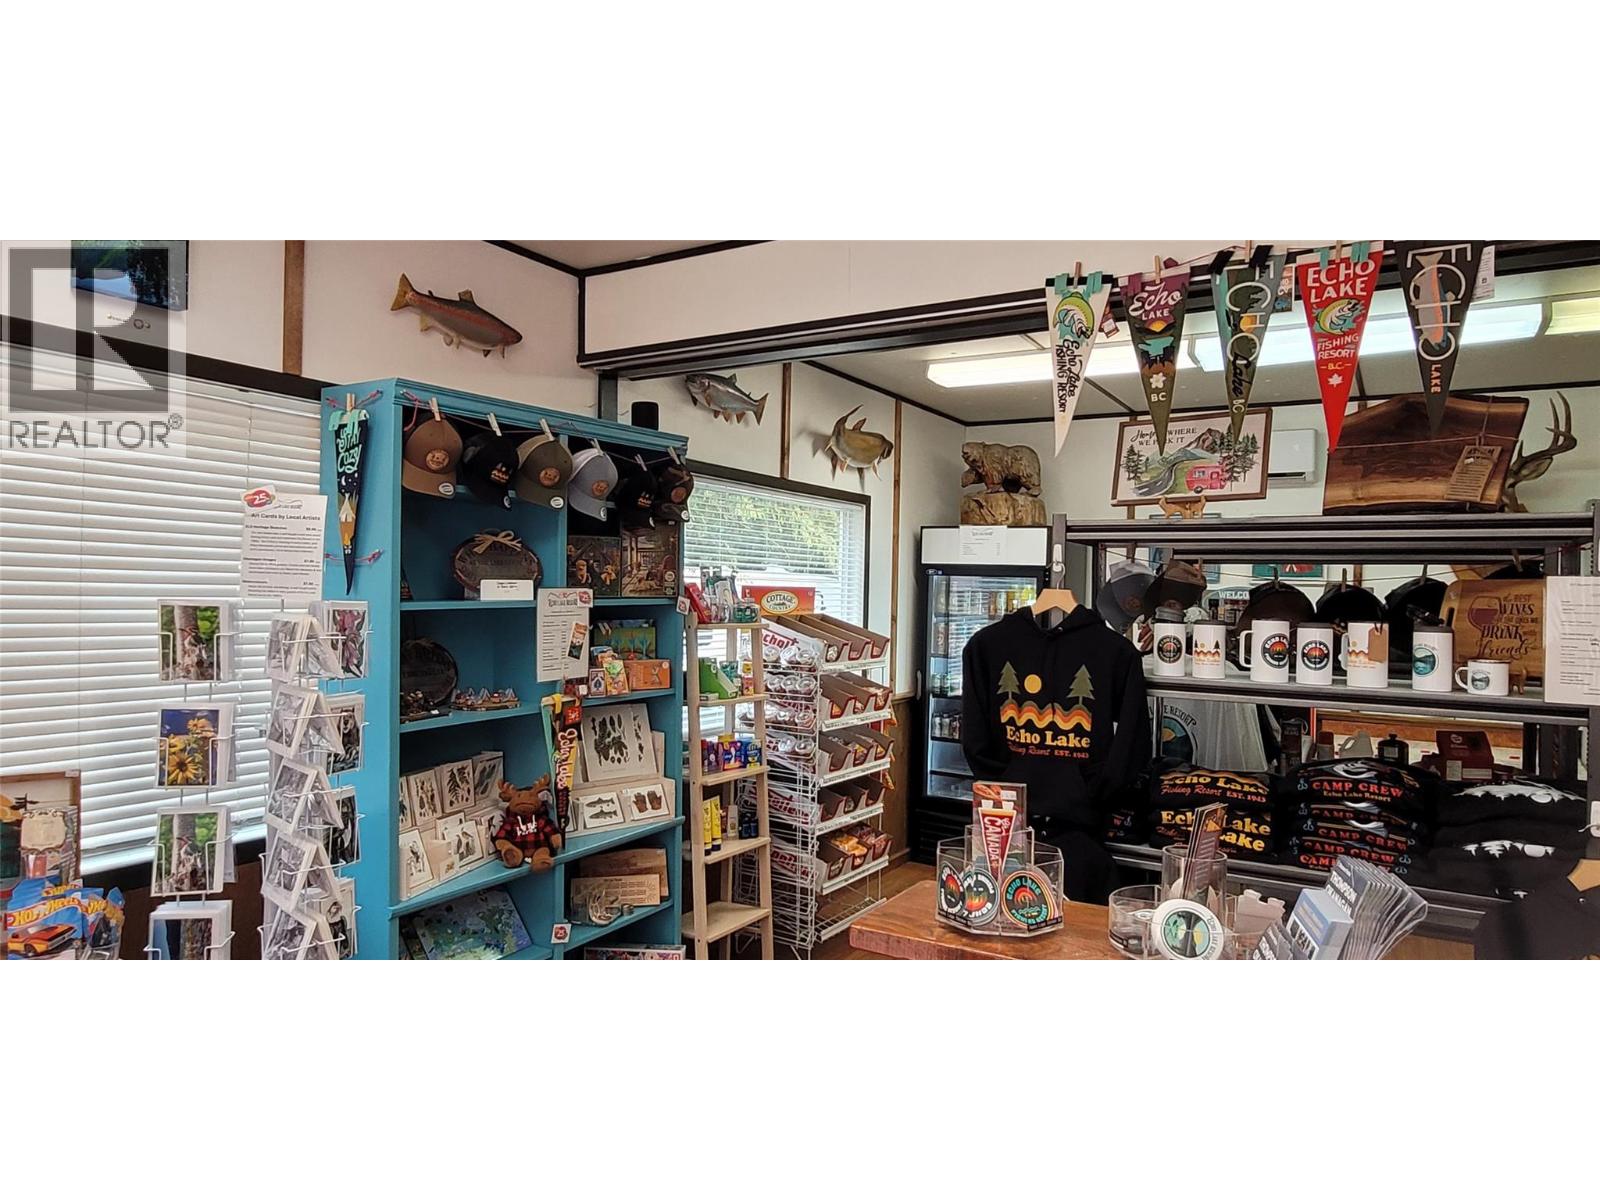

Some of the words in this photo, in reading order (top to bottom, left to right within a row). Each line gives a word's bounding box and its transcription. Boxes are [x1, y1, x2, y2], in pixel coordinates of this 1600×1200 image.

[1307, 258, 1375, 287] ECHO
[1129, 281, 1183, 317] Echo
[1309, 277, 1369, 304] LAKE
[1142, 307, 1170, 321] LAKE
[1317, 333, 1360, 351] FISHING
[1318, 349, 1356, 360] RESORT
[1430, 363, 1442, 393] LAKE
[1150, 391, 1167, 403] BC
[253, 493, 268, 505] 25
[1218, 590, 1251, 600] WELCO
[1481, 625, 1523, 642] DRINK
[1006, 725, 1041, 745] Echo
[1044, 731, 1091, 749] Lake
[1312, 782, 1353, 791] CAMP
[1358, 782, 1404, 797] CREW
[984, 816, 1002, 860] CANADA
